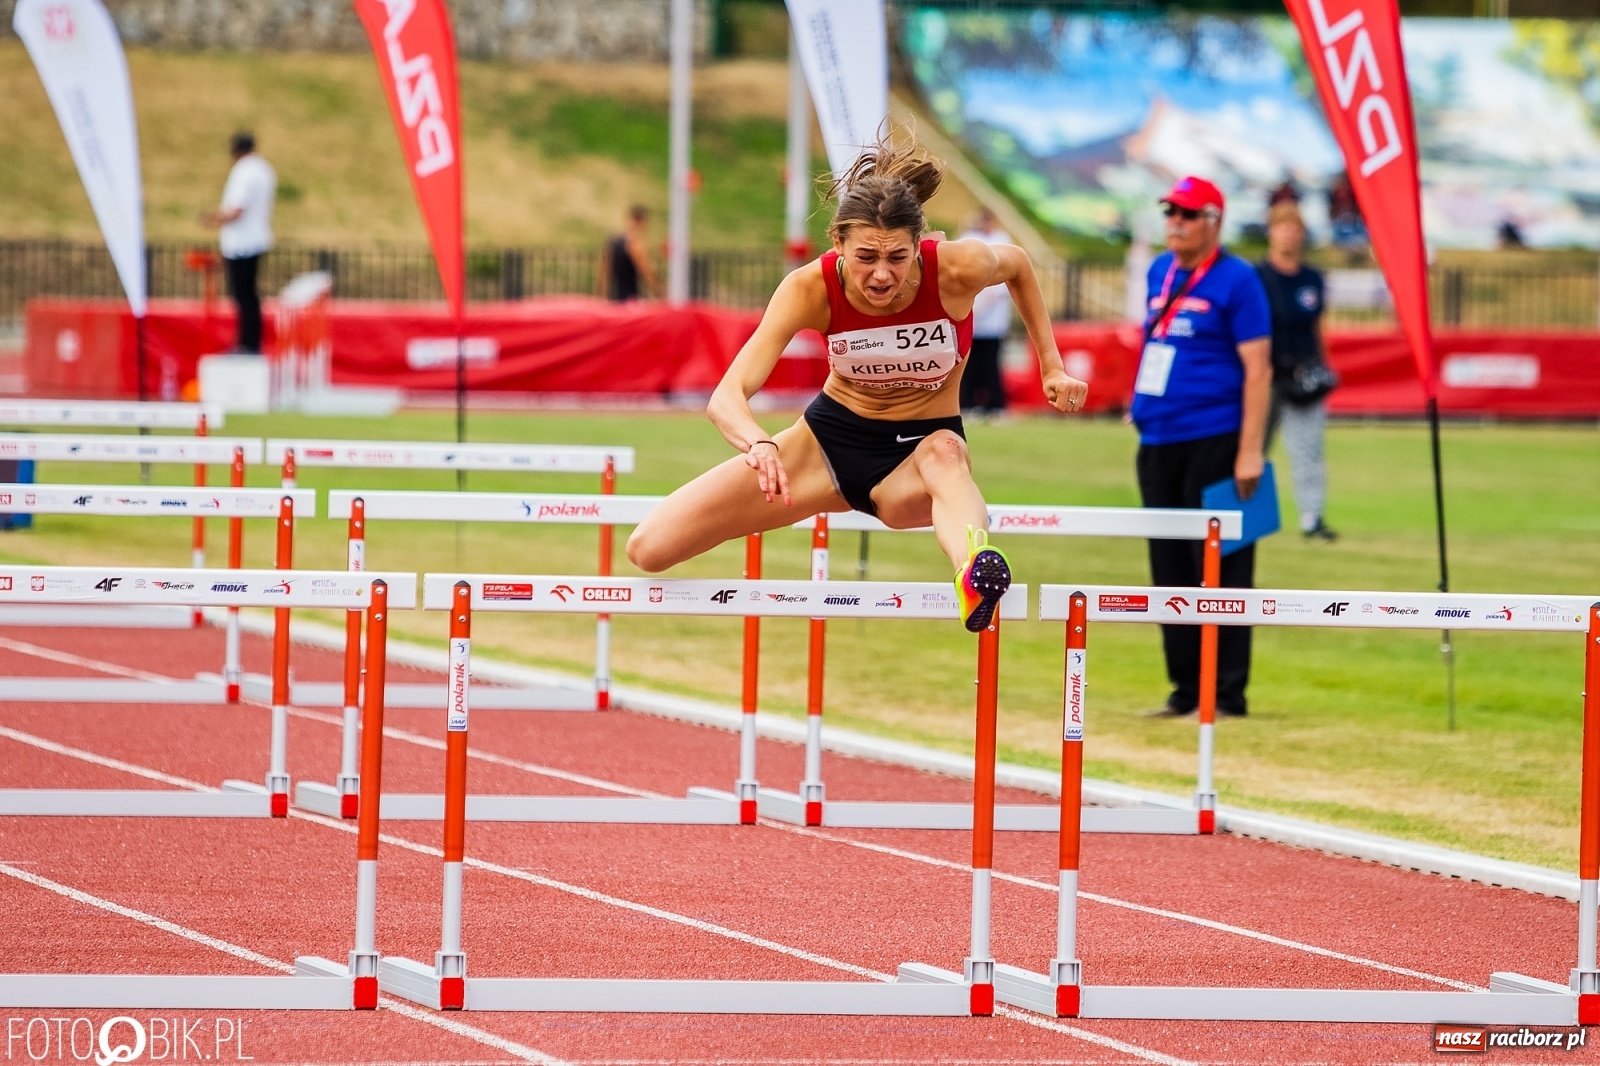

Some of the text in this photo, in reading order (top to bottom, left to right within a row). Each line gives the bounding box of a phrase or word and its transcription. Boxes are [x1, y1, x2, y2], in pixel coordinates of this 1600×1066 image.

[896, 324, 947, 349] 524
[850, 341, 884, 351] Racibórz
[851, 360, 941, 374] KIEPURA
[538, 503, 600, 519] polanik
[998, 514, 1060, 530] polanik
[94, 578, 122, 592] 4F
[584, 588, 628, 600] ORLEN
[710, 590, 738, 604] 4F
[824, 597, 860, 605] 4MOVE
[1199, 601, 1243, 612] ORLEN
[1322, 602, 1350, 616] 4F
[1435, 610, 1471, 618] 4MOVE
[453, 662, 465, 714] polanik
[1070, 672, 1082, 724] polanik
